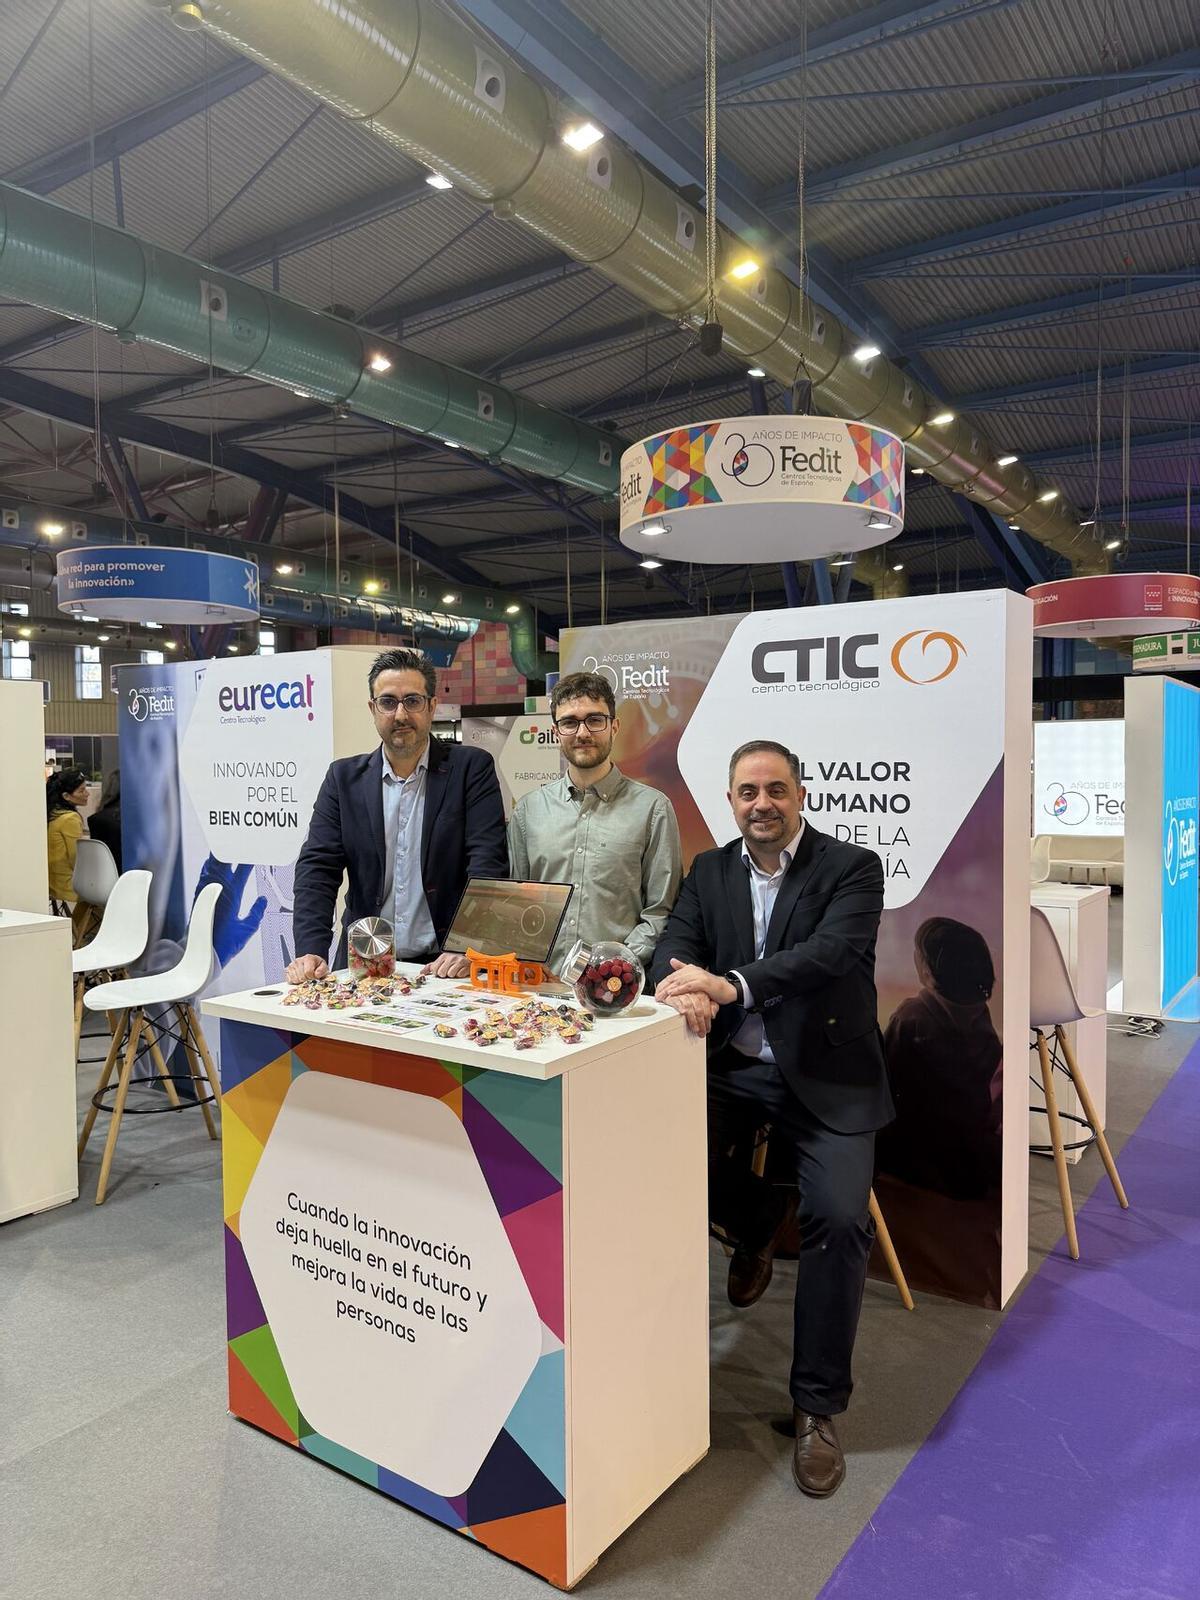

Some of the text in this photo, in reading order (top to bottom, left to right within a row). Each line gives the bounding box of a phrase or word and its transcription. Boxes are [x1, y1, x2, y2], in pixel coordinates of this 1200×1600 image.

[752, 430, 843, 443] AÑOS DE IMPACTO
[779, 445, 842, 475] Fedit
[70, 561, 83, 573] red
[84, 563, 105, 575] para
[107, 562, 165, 573] promover
[602, 651, 670, 663] AÑOS DE IMPACTO
[751, 633, 879, 684] CTIC
[621, 664, 670, 689] Fedit
[751, 678, 881, 694] centro tecnológico
[149, 695, 175, 713] Fedit
[219, 715, 266, 725] Centro Tecnológico
[213, 761, 298, 778] INNOVANDO
[800, 761, 911, 782] L VALOR
[247, 787, 299, 803] POR EL
[1070, 780, 1096, 790] AÑOS
[1097, 781, 1111, 790] DE
[801, 793, 911, 814] UMANO
[209, 808, 298, 828] BIEN COMÚN
[835, 824, 911, 847] DE LA
[287, 1192, 471, 1270] Cuando la innovación
[276, 1218, 488, 1313] deja huella en el futuro y
[292, 1253, 469, 1333] mejora la vida de las
[336, 1299, 416, 1343] personas
